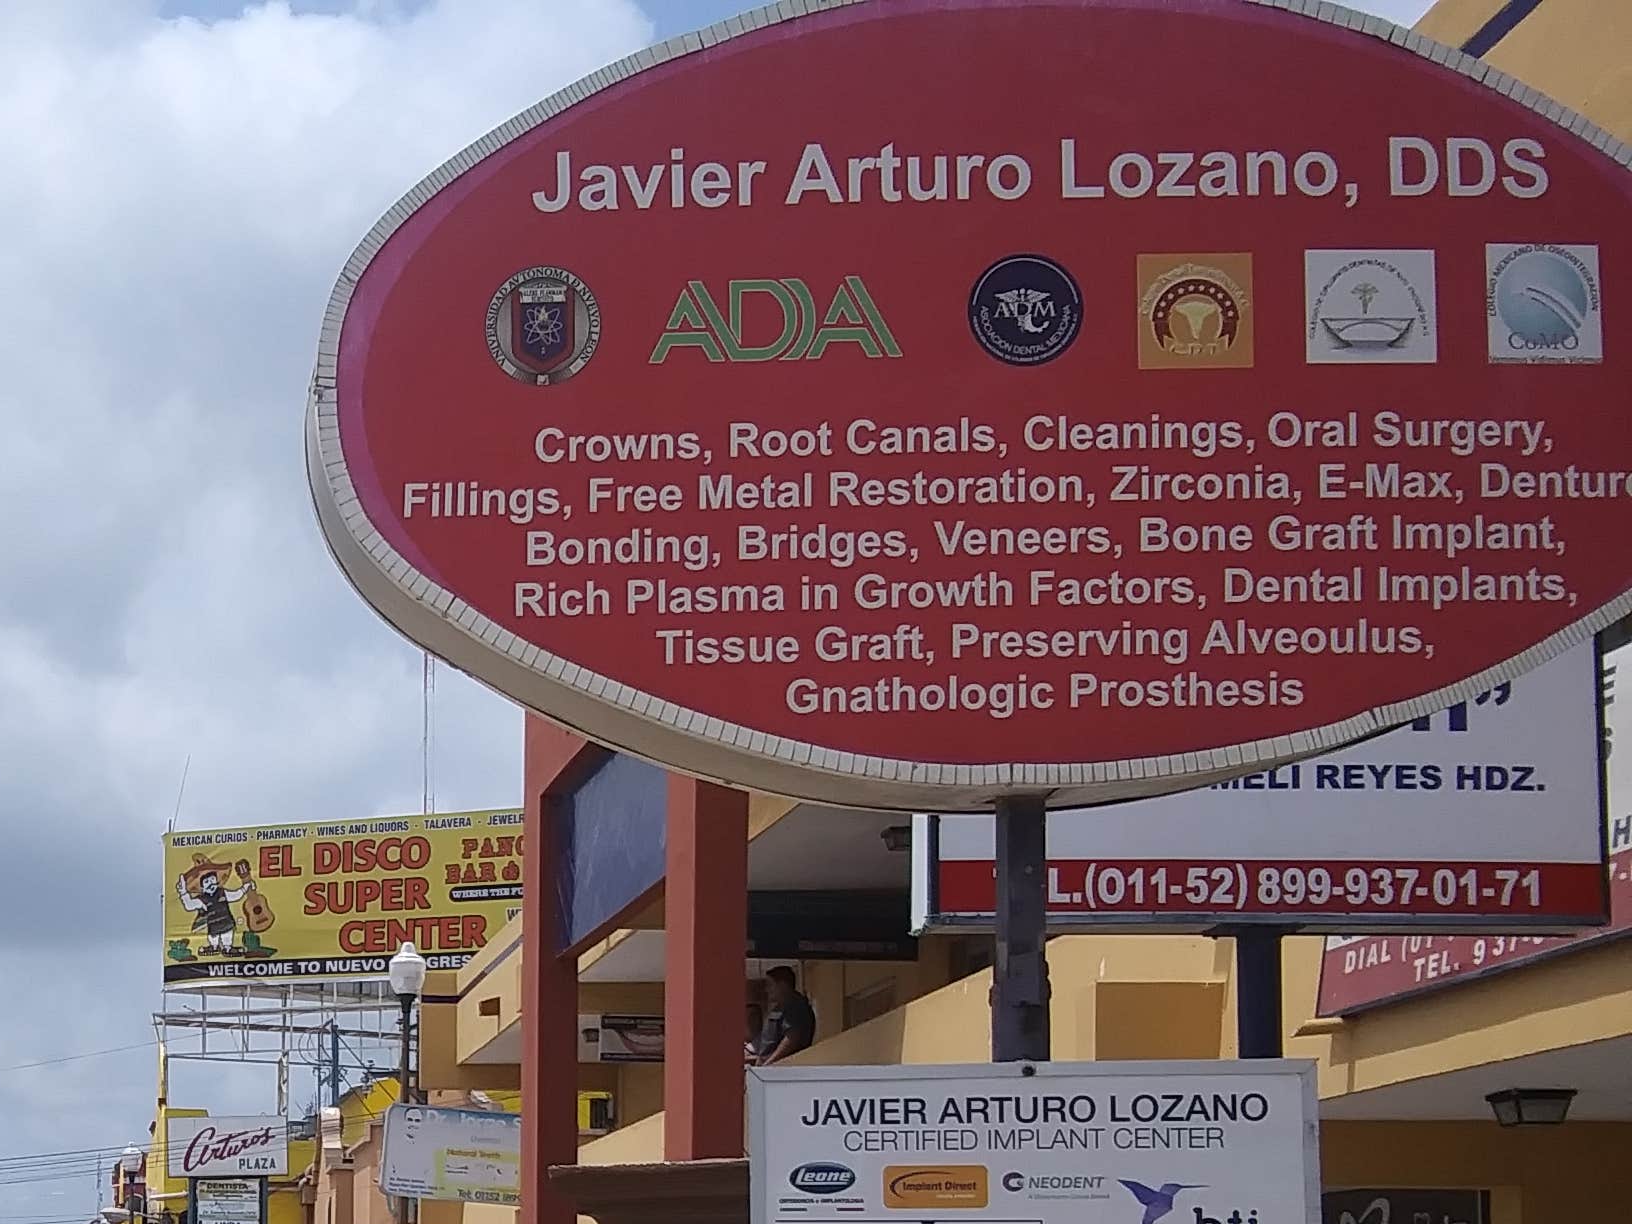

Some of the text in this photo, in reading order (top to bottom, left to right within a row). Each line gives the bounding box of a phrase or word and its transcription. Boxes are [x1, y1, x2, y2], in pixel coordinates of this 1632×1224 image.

[532, 136, 1549, 212] Javier Arturo Lozano, DDS
[648, 275, 903, 364] ADA
[534, 411, 1553, 466] Crowns, Root Canals, Cleanings, Oral Surgery,
[403, 461, 1632, 524] Fillings, Free Metal Restoration, Zirconia, E-Max, Dentur
[525, 514, 1566, 570] Bonding, Bridges, Veneers, Bone Graft Implant,
[514, 565, 1577, 617] Rich Plasma in Growth Factors, Dental Implants,
[655, 618, 1435, 665] Tissue Graft, Preserving Alveoulus,
[785, 671, 1305, 719] Gnathologic Prosthesis
[1316, 764, 1442, 791] REYES
[1456, 766, 1546, 792] HDZ.
[172, 818, 472, 847] MEXICAN CURIOS PHARMACY WINES AND LIQUORS TALAVERA
[259, 836, 432, 878] EL DISCO
[445, 863, 497, 885] BAR
[993, 865, 1542, 910] L.(011-52) 899-937-01-71
[304, 876, 431, 915] SUPER
[339, 914, 488, 954] CENTER
[208, 958, 385, 977] WELCOME TO NUEVO
[1345, 944, 1391, 974] DIAL
[1415, 951, 1460, 982] TEL.
[802, 1093, 1268, 1125] JAVIER ARTURO LOZANO
[844, 1127, 1224, 1151] CERTIFIED IMPLANT CENTER
[239, 1158, 276, 1170] PLAZA
[796, 1168, 851, 1186] Leone
[206, 1182, 248, 1191] DENTISTA
[903, 1181, 976, 1193] Implant Direct
[1029, 1177, 1104, 1189] NEODENT
